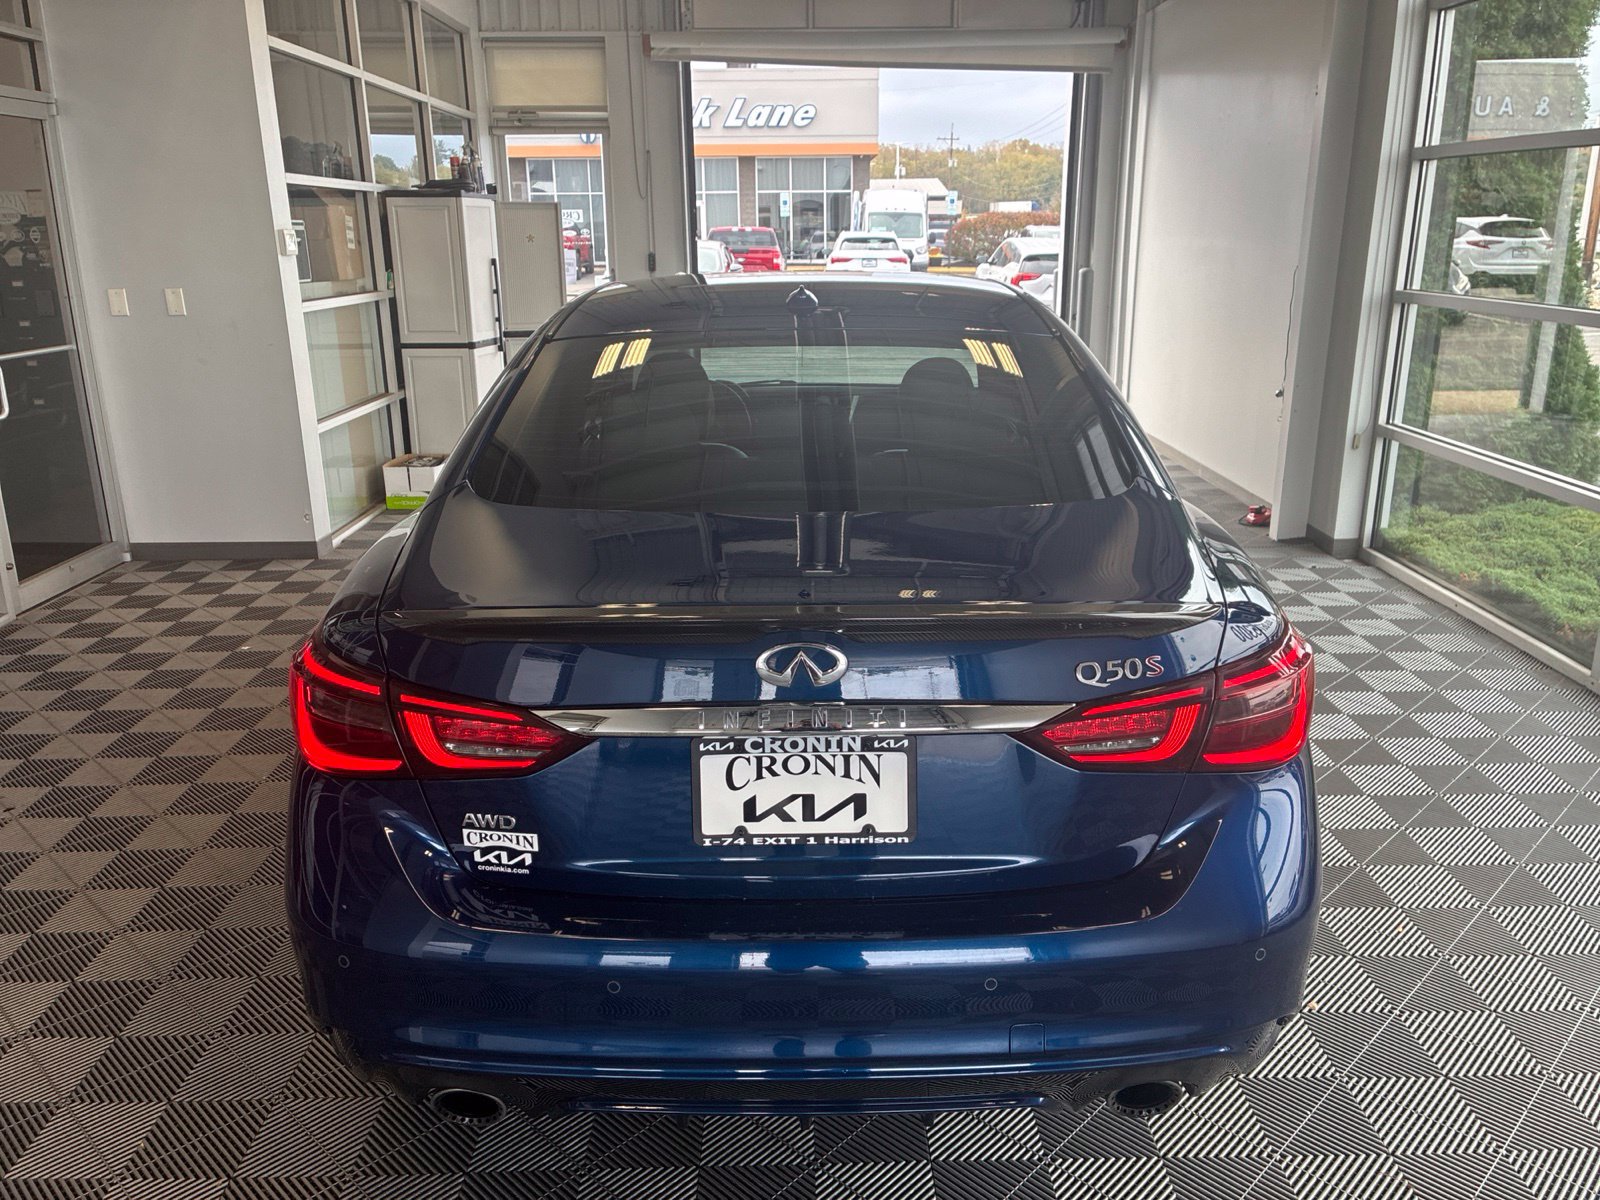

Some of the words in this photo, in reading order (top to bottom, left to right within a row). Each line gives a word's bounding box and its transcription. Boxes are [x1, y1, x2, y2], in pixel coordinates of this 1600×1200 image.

[692, 98, 720, 128] k
[723, 98, 817, 128] Lane
[1075, 655, 1164, 687] Q50S
[698, 707, 907, 731] INFINITI
[744, 736, 861, 753] CRONIN
[725, 754, 884, 791] CRONIN
[743, 793, 867, 822] KIA
[462, 813, 516, 829] AWD
[466, 831, 535, 849] CRONIN
[702, 838, 746, 846] I-74
[752, 837, 800, 845] EXIT
[806, 837, 817, 845] 1
[824, 835, 909, 844] Harrison
[473, 849, 533, 867] KIA
[477, 864, 530, 874] croninkia.com
